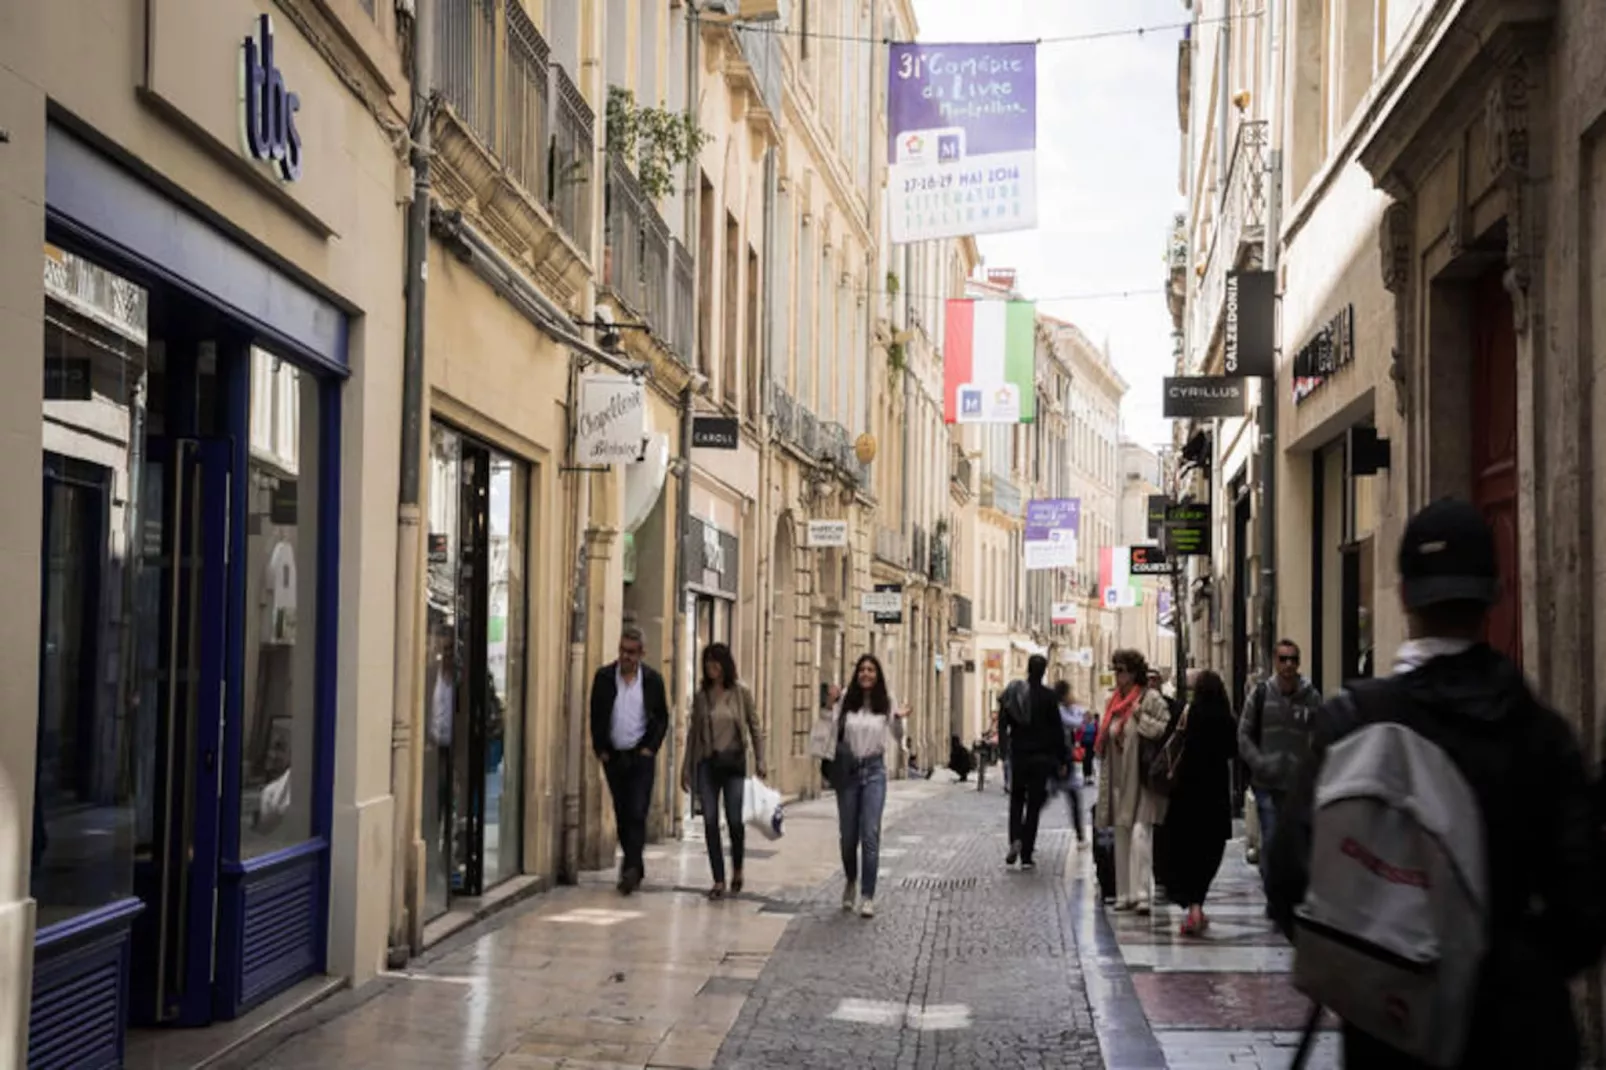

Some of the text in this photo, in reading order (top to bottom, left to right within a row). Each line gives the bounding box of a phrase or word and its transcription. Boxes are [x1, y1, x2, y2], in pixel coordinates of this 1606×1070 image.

[240, 13, 303, 182] tbs
[959, 168, 983, 185] MAI
[1226, 276, 1238, 372] CALZEDONIA
[1169, 387, 1240, 398] CYRILLUS
[695, 431, 734, 443] CAROLL
